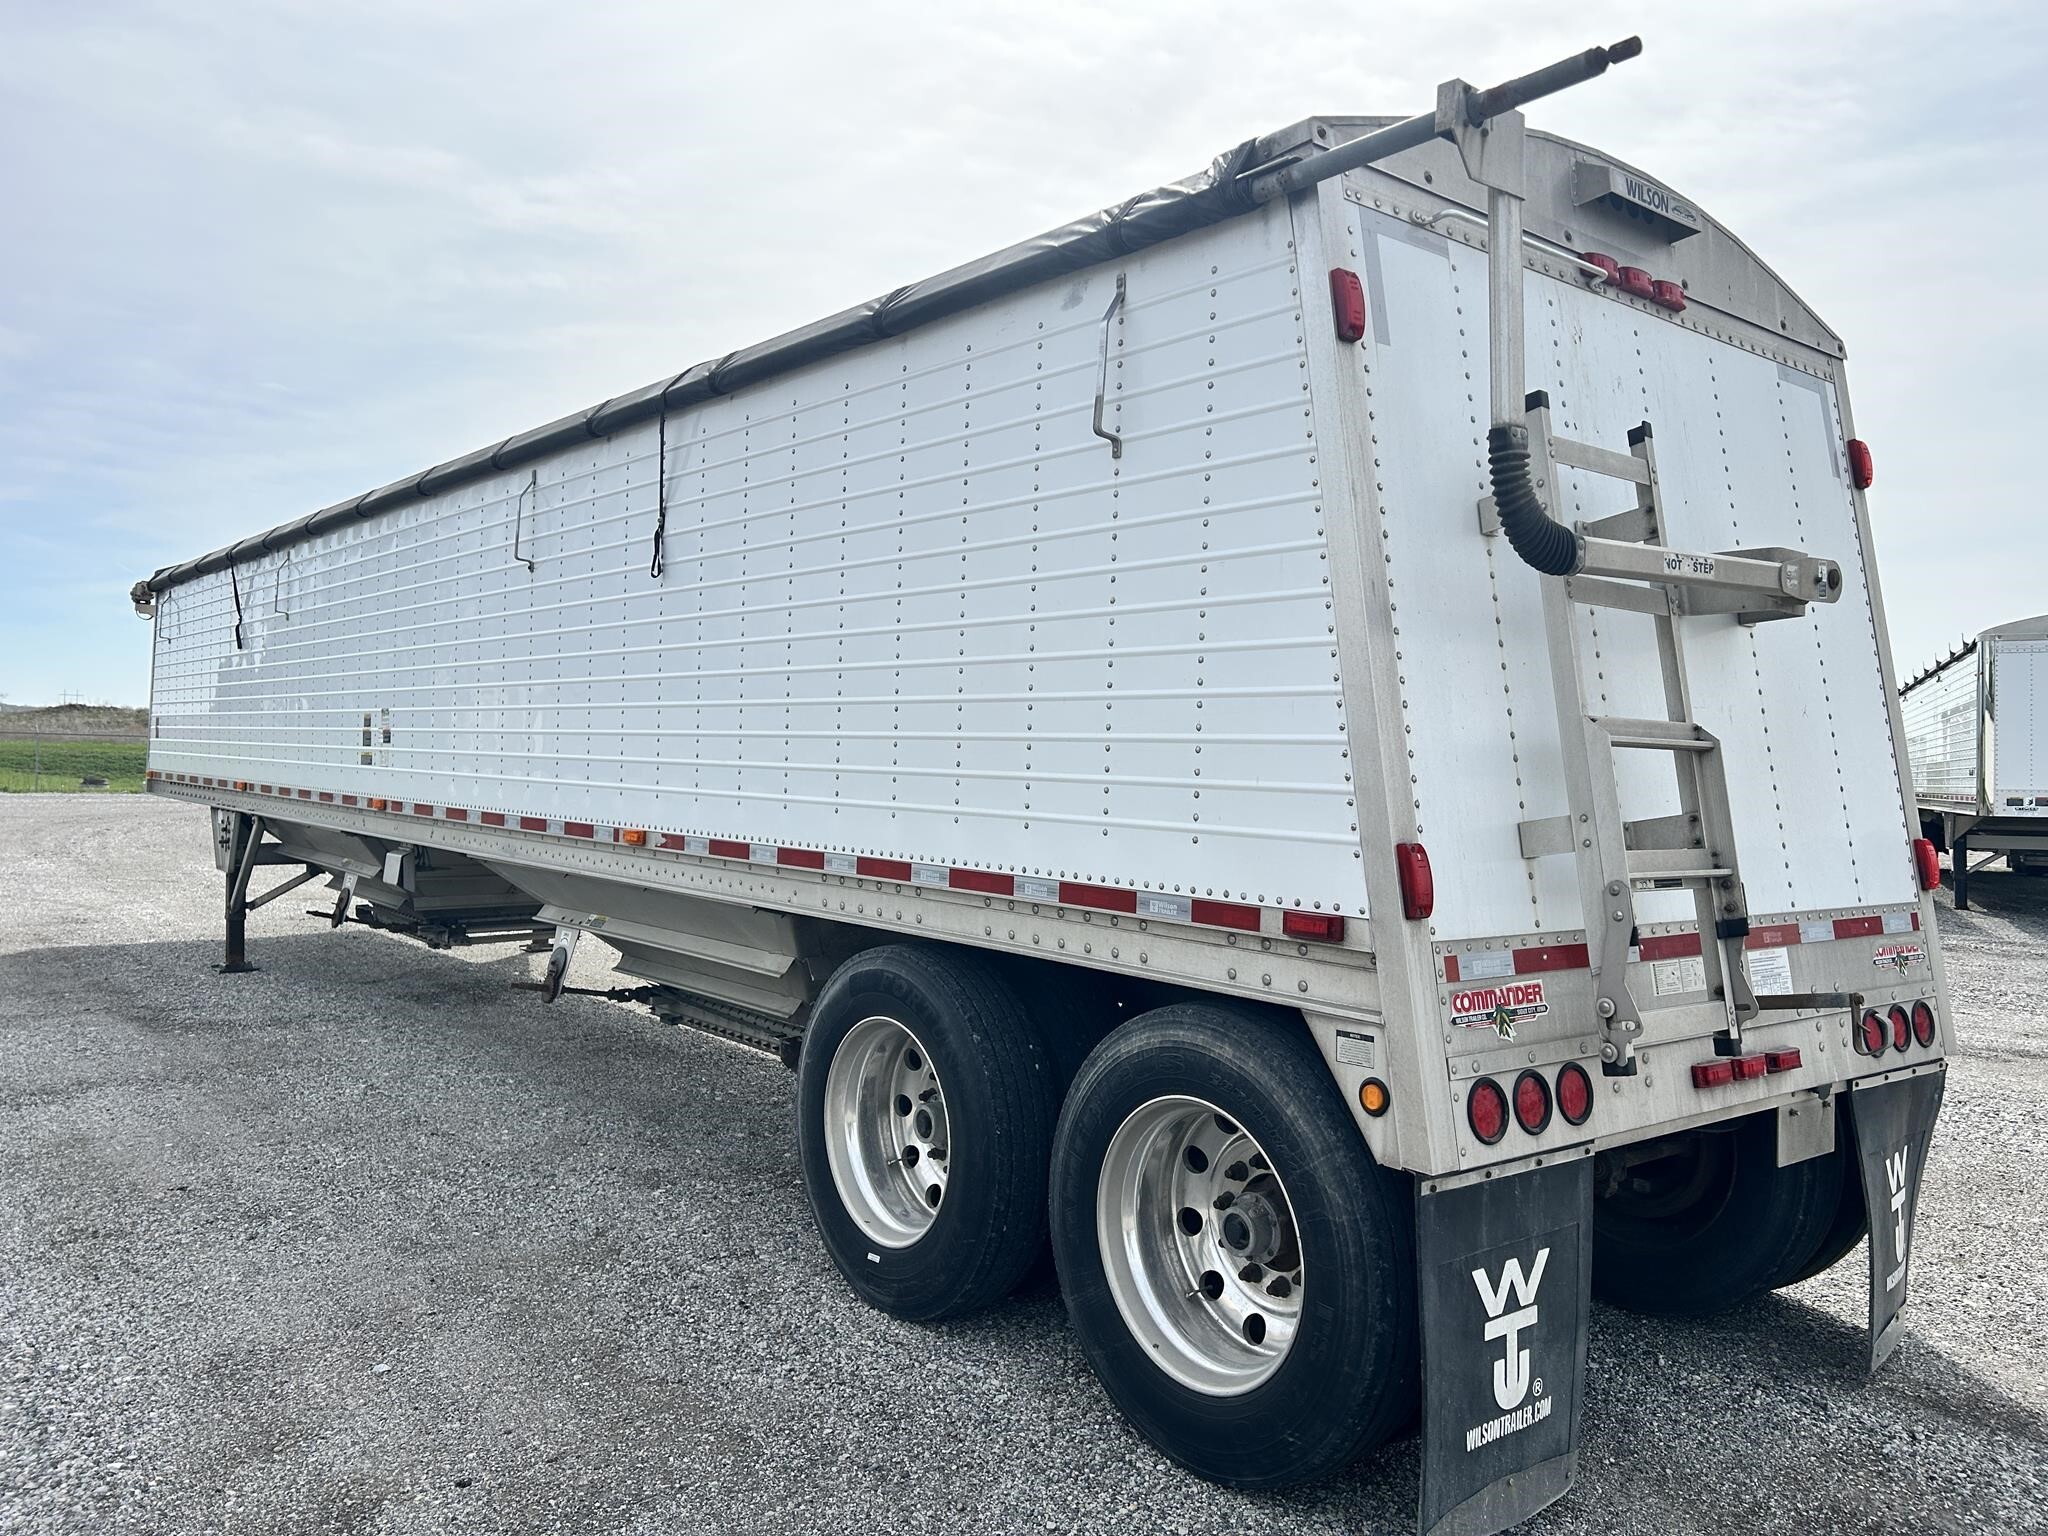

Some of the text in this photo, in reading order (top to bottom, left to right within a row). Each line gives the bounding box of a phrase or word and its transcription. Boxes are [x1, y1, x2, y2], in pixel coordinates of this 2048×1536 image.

[1626, 178, 1669, 213] WILSON
[1693, 562, 1714, 574] STEP
[1453, 983, 1544, 1013] COMMANDER
[1466, 1395, 1552, 1452] WILSONTRAILER.COM
